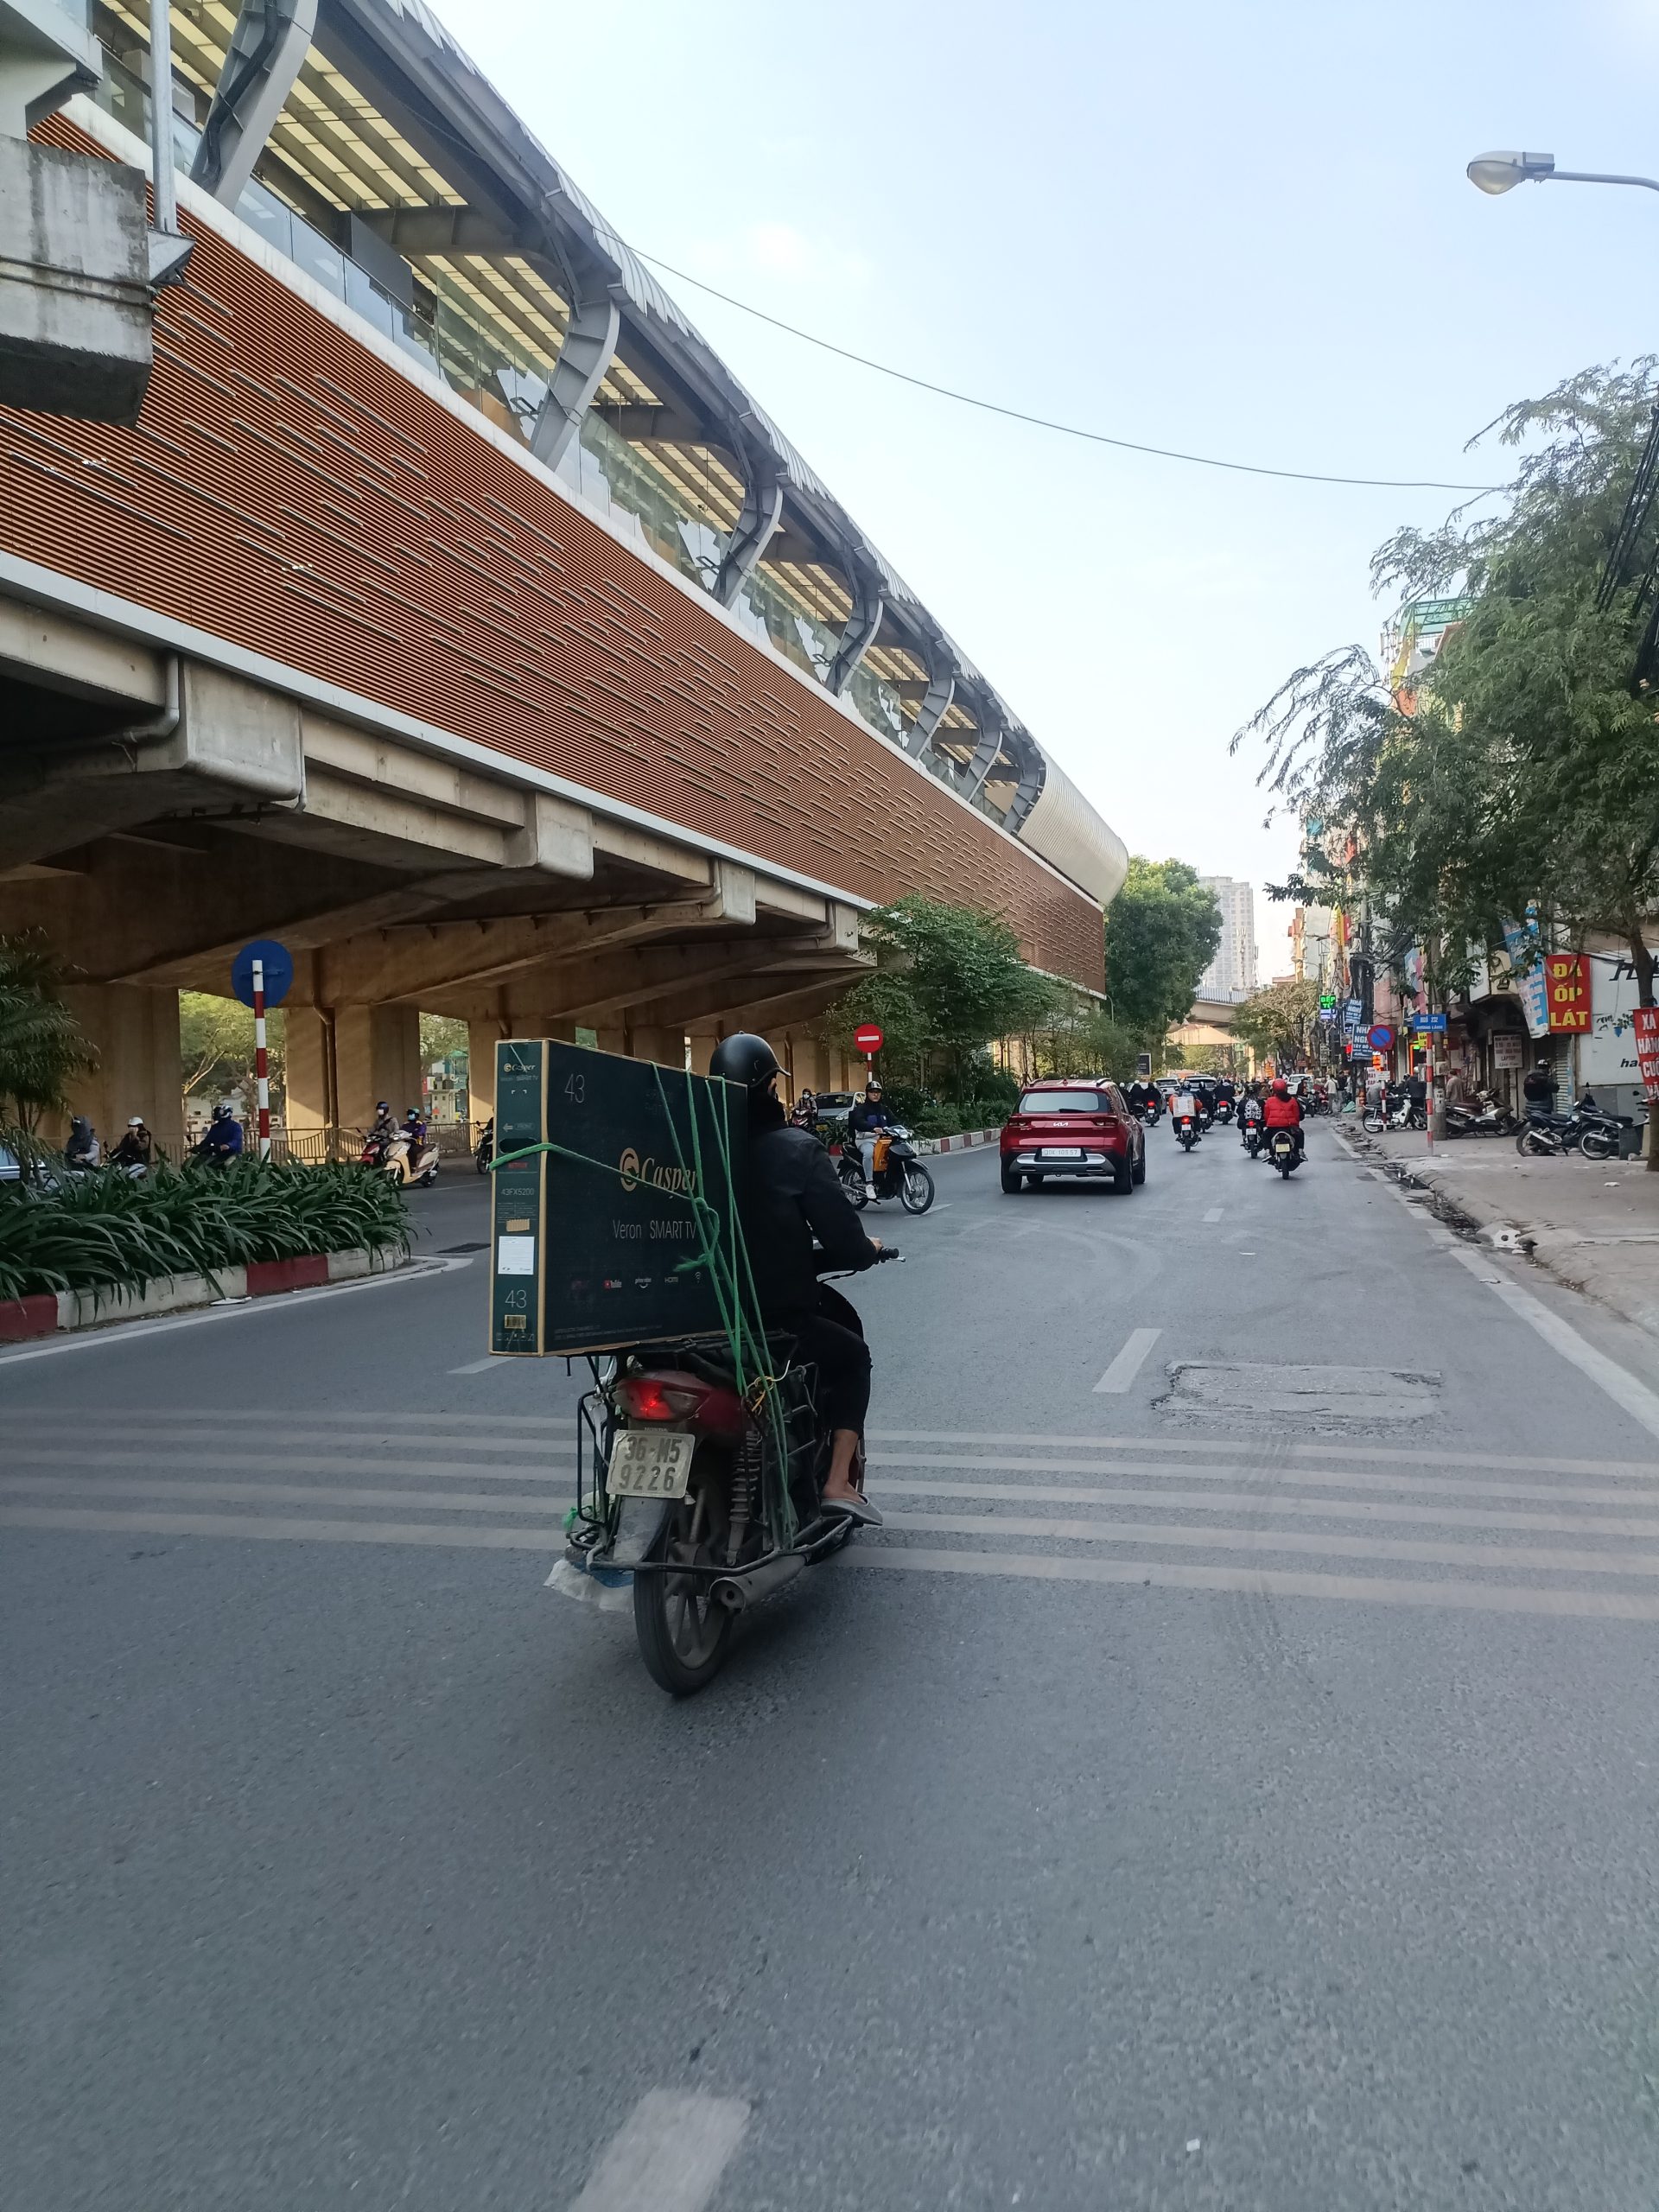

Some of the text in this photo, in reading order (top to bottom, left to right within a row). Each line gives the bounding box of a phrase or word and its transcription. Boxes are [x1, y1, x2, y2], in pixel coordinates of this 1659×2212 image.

[1554, 982, 1583, 1002] ỐP
[1550, 1009, 1588, 1027] LÁT
[564, 1073, 585, 1103] 43
[641, 1157, 696, 1199] Casper
[612, 1219, 696, 1239] Veron SMART TV
[505, 1289, 527, 1308] 43
[624, 1435, 683, 1464] 36-M5
[619, 1464, 676, 1492] 9226
